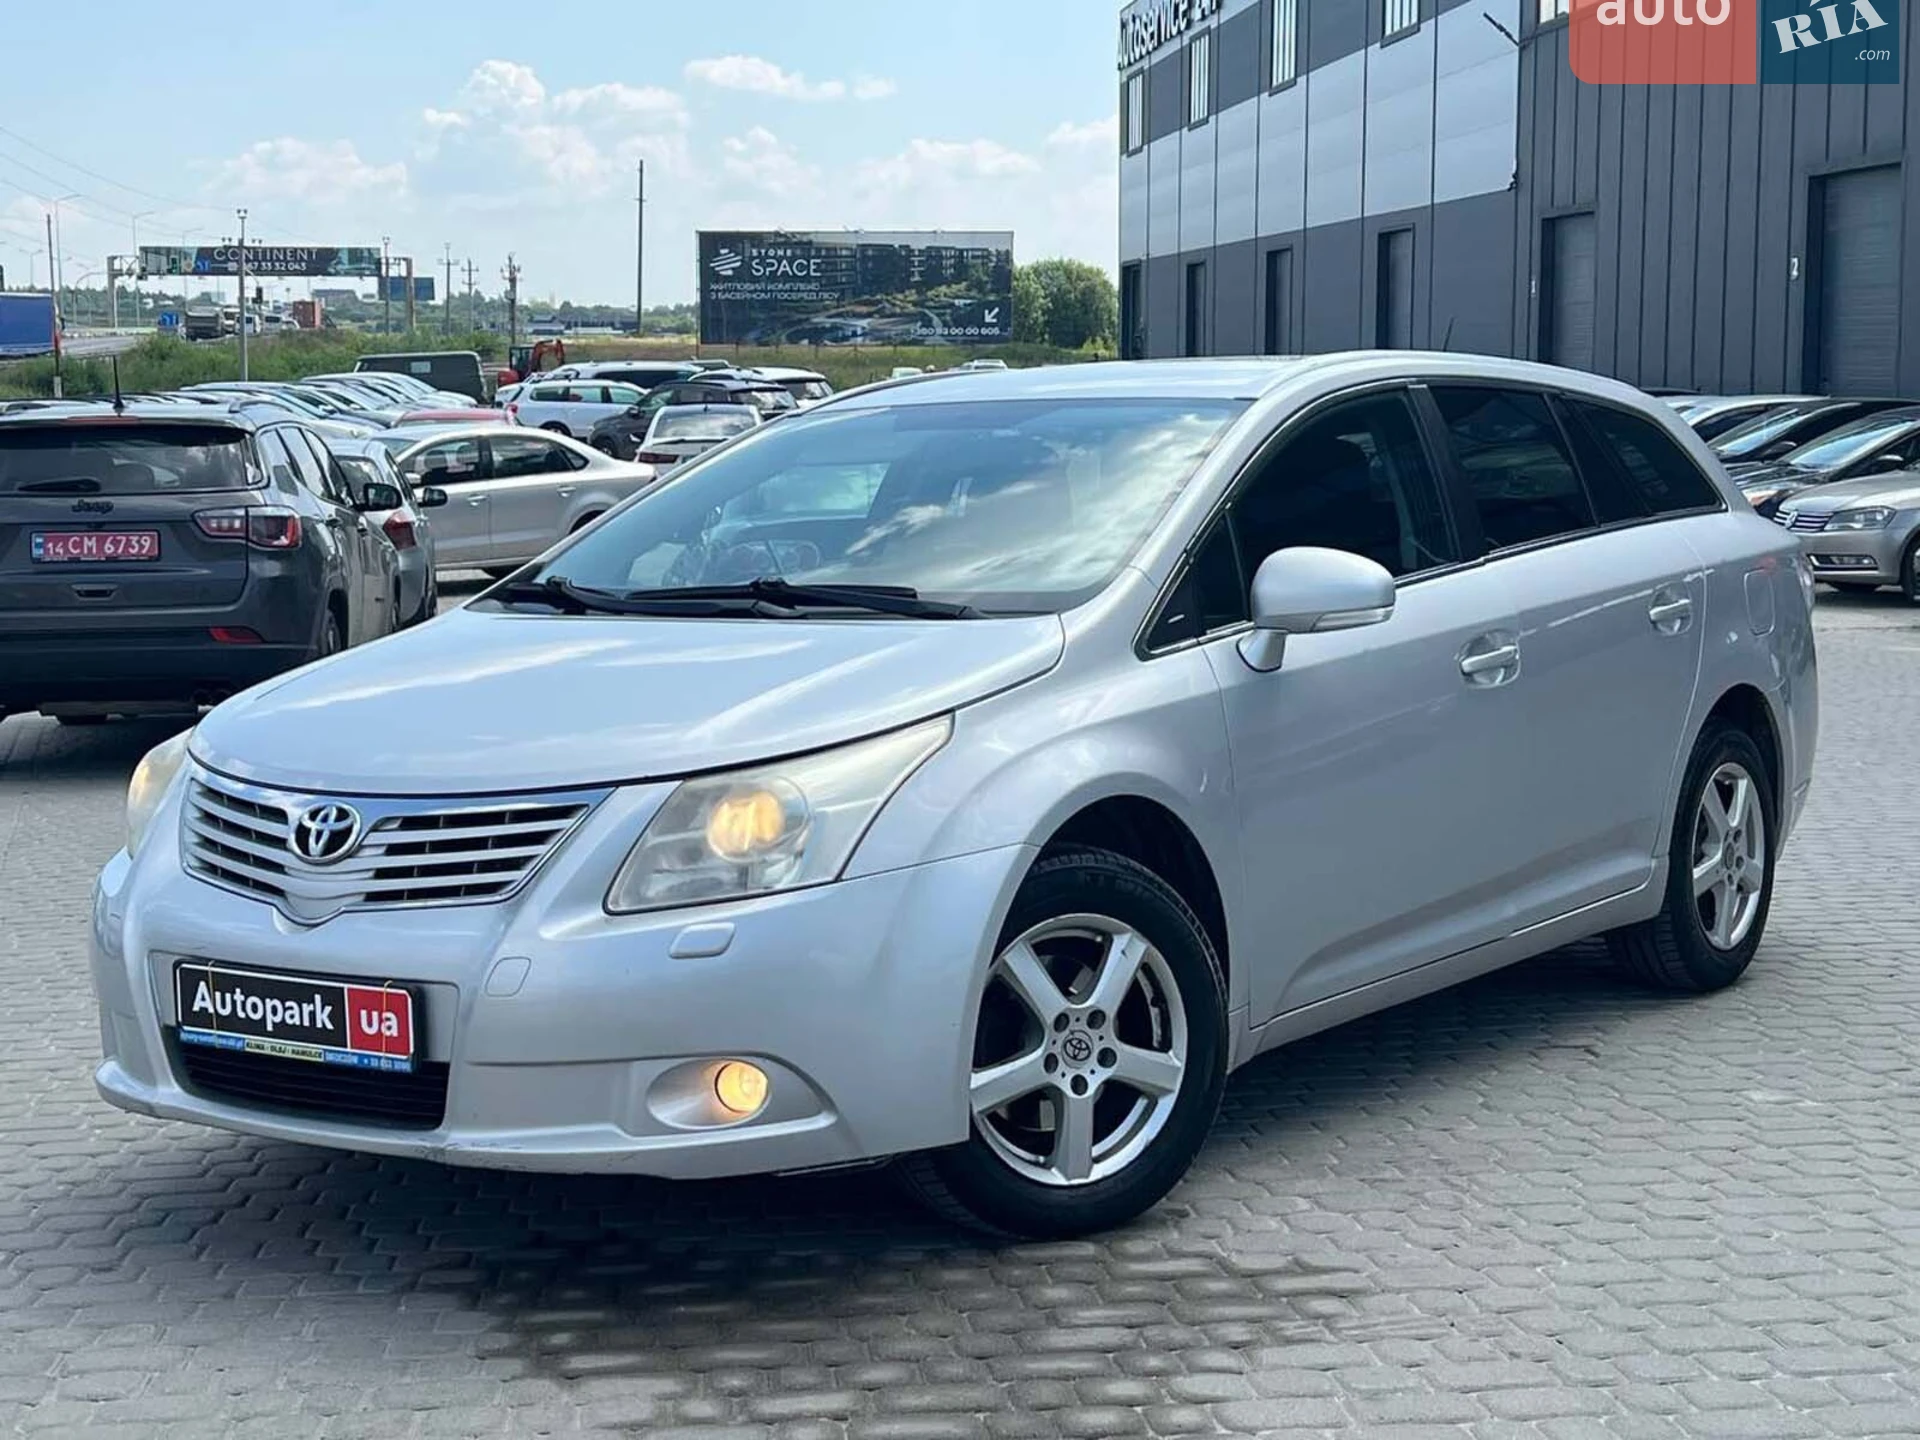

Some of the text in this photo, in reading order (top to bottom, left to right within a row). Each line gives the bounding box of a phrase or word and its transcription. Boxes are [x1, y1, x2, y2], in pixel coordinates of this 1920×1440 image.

[213, 247, 318, 261] CONTINENT
[751, 258, 822, 277] SPACE
[72, 499, 114, 514] Jeep
[46, 536, 151, 555] 14 CM 6739
[192, 980, 399, 1038] Autopark ua
